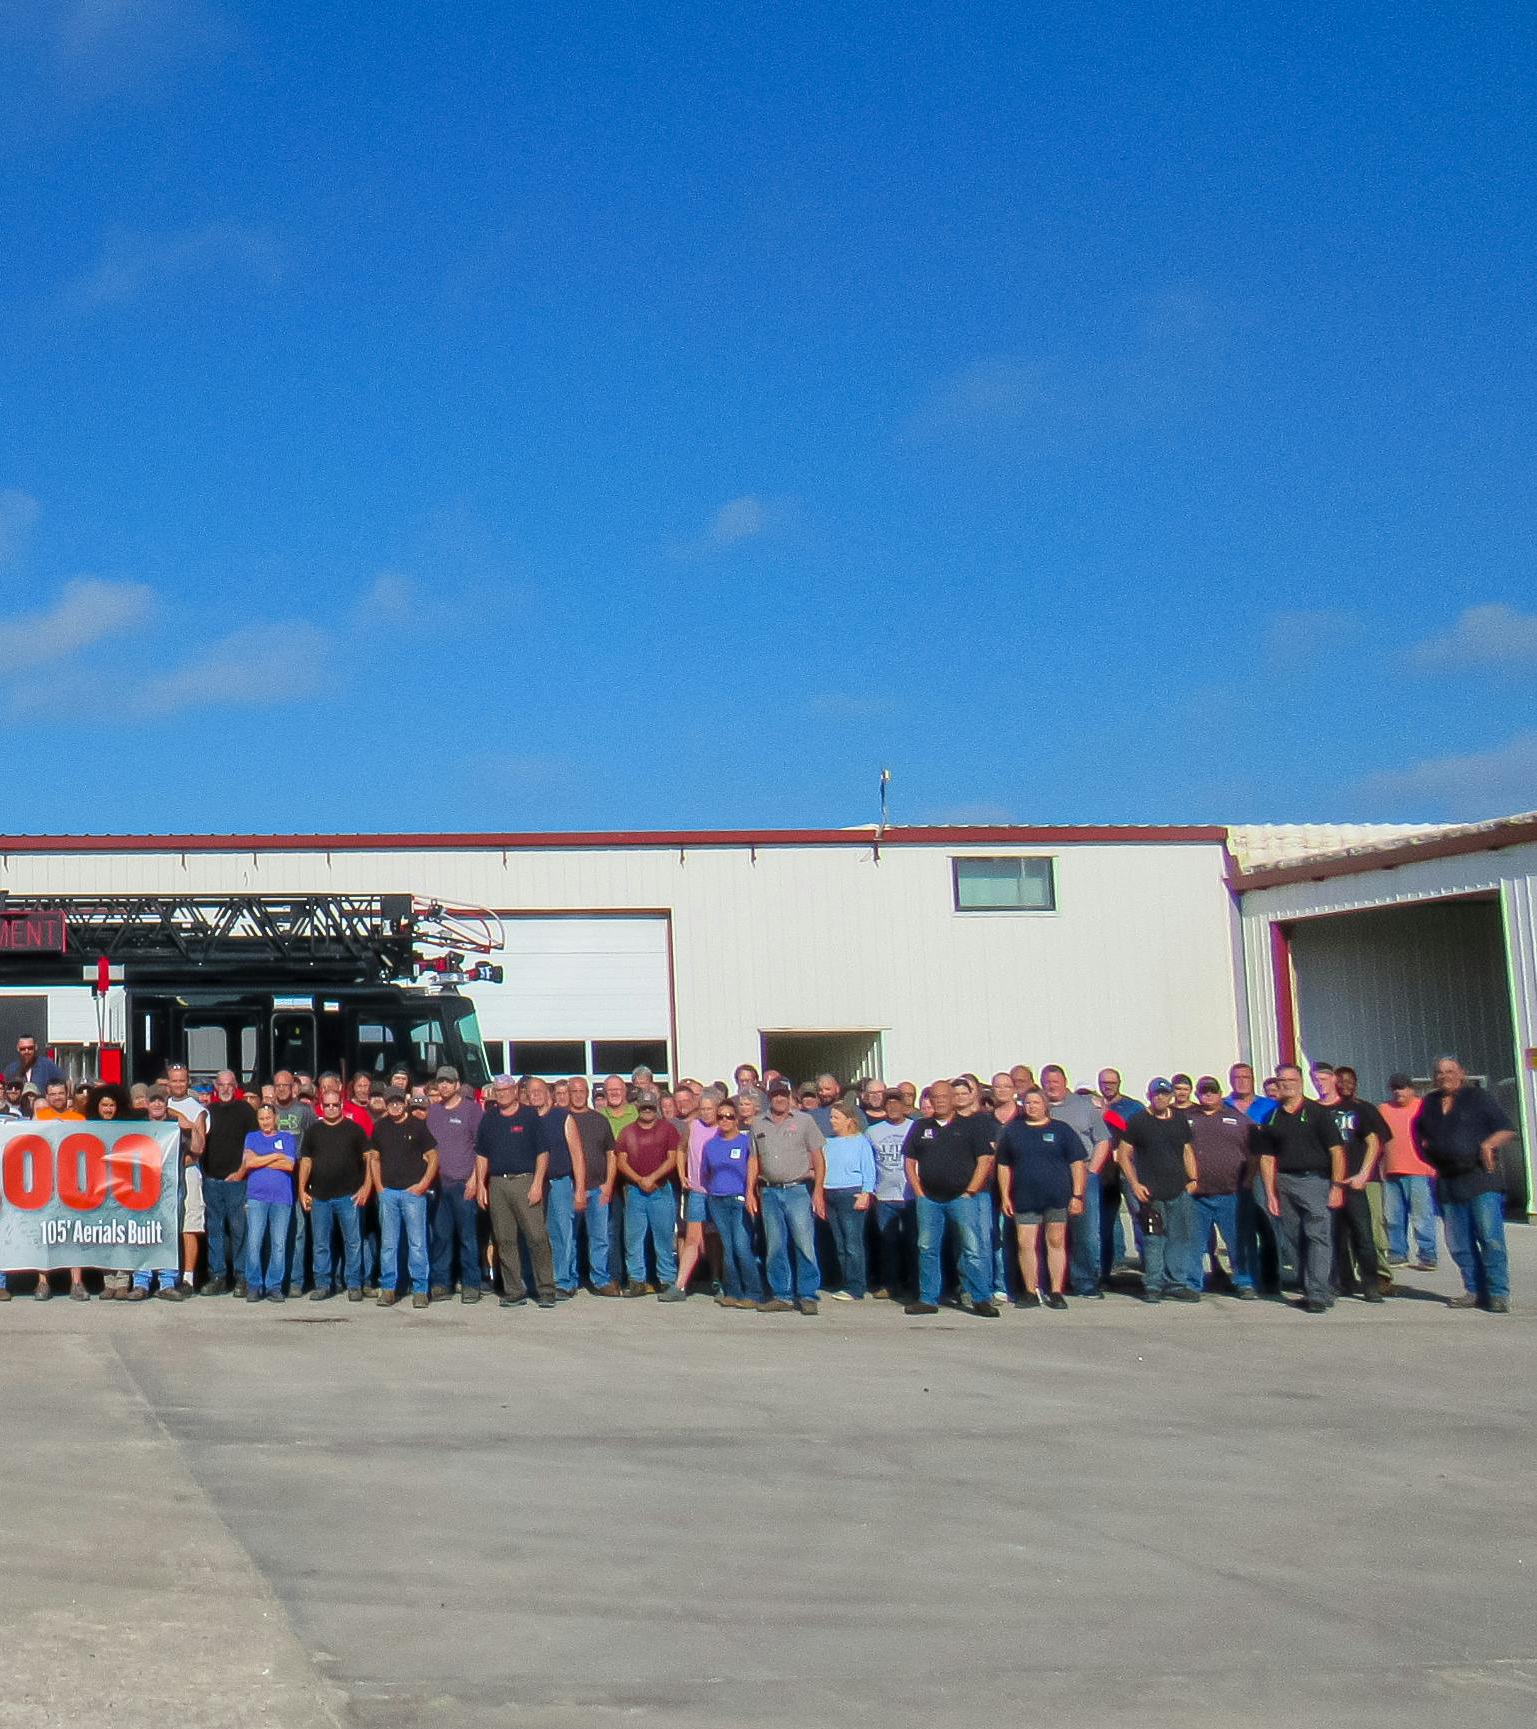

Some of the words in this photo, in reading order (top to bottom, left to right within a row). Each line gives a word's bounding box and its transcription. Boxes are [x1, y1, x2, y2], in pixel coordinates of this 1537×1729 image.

[40, 1219, 72, 1244] 105'
[73, 1218, 125, 1244] Aerials
[127, 1219, 163, 1244] Built
